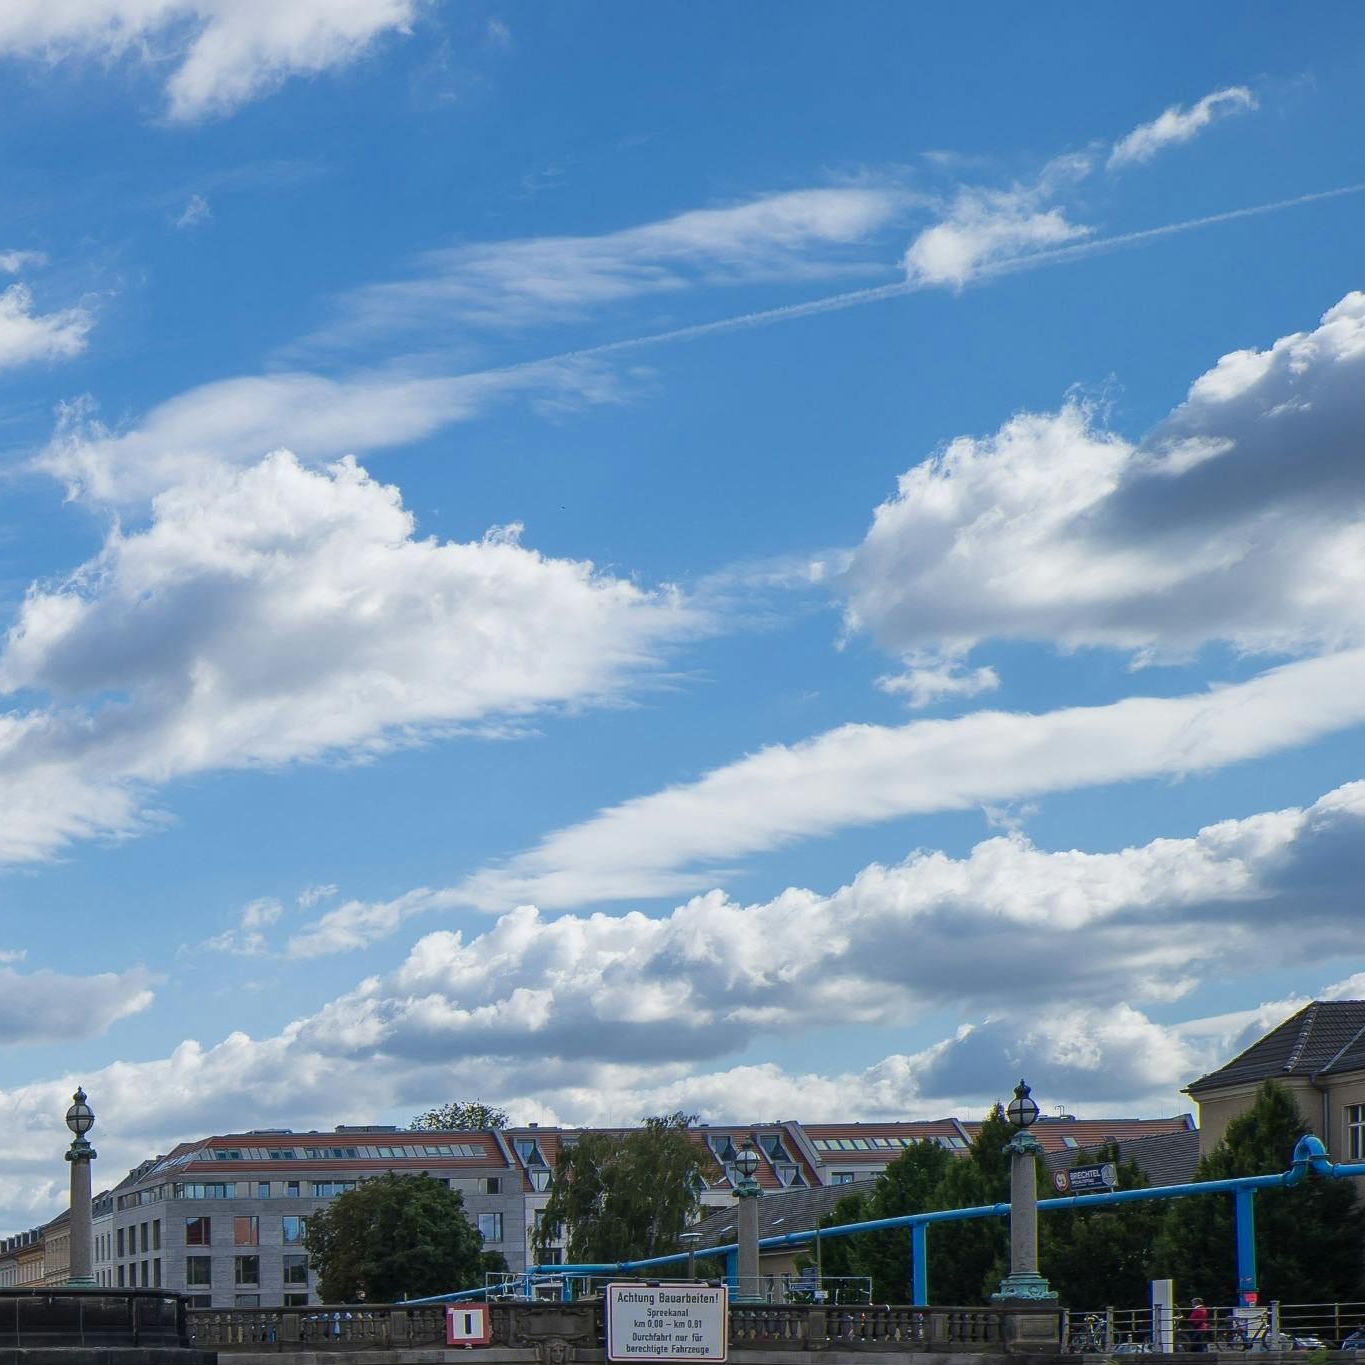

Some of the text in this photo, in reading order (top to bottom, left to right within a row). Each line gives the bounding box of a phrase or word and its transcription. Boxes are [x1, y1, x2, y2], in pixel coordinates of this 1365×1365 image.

[617, 1292, 719, 1305] Achtung Bauarbeiten!
[646, 1308, 689, 1318] Spreekanal
[634, 1319, 646, 1328] km
[673, 1320, 685, 1329] km
[632, 1332, 703, 1342] Durchfahrt nur für
[626, 1344, 709, 1355] berechtigte Fahrzeuge
